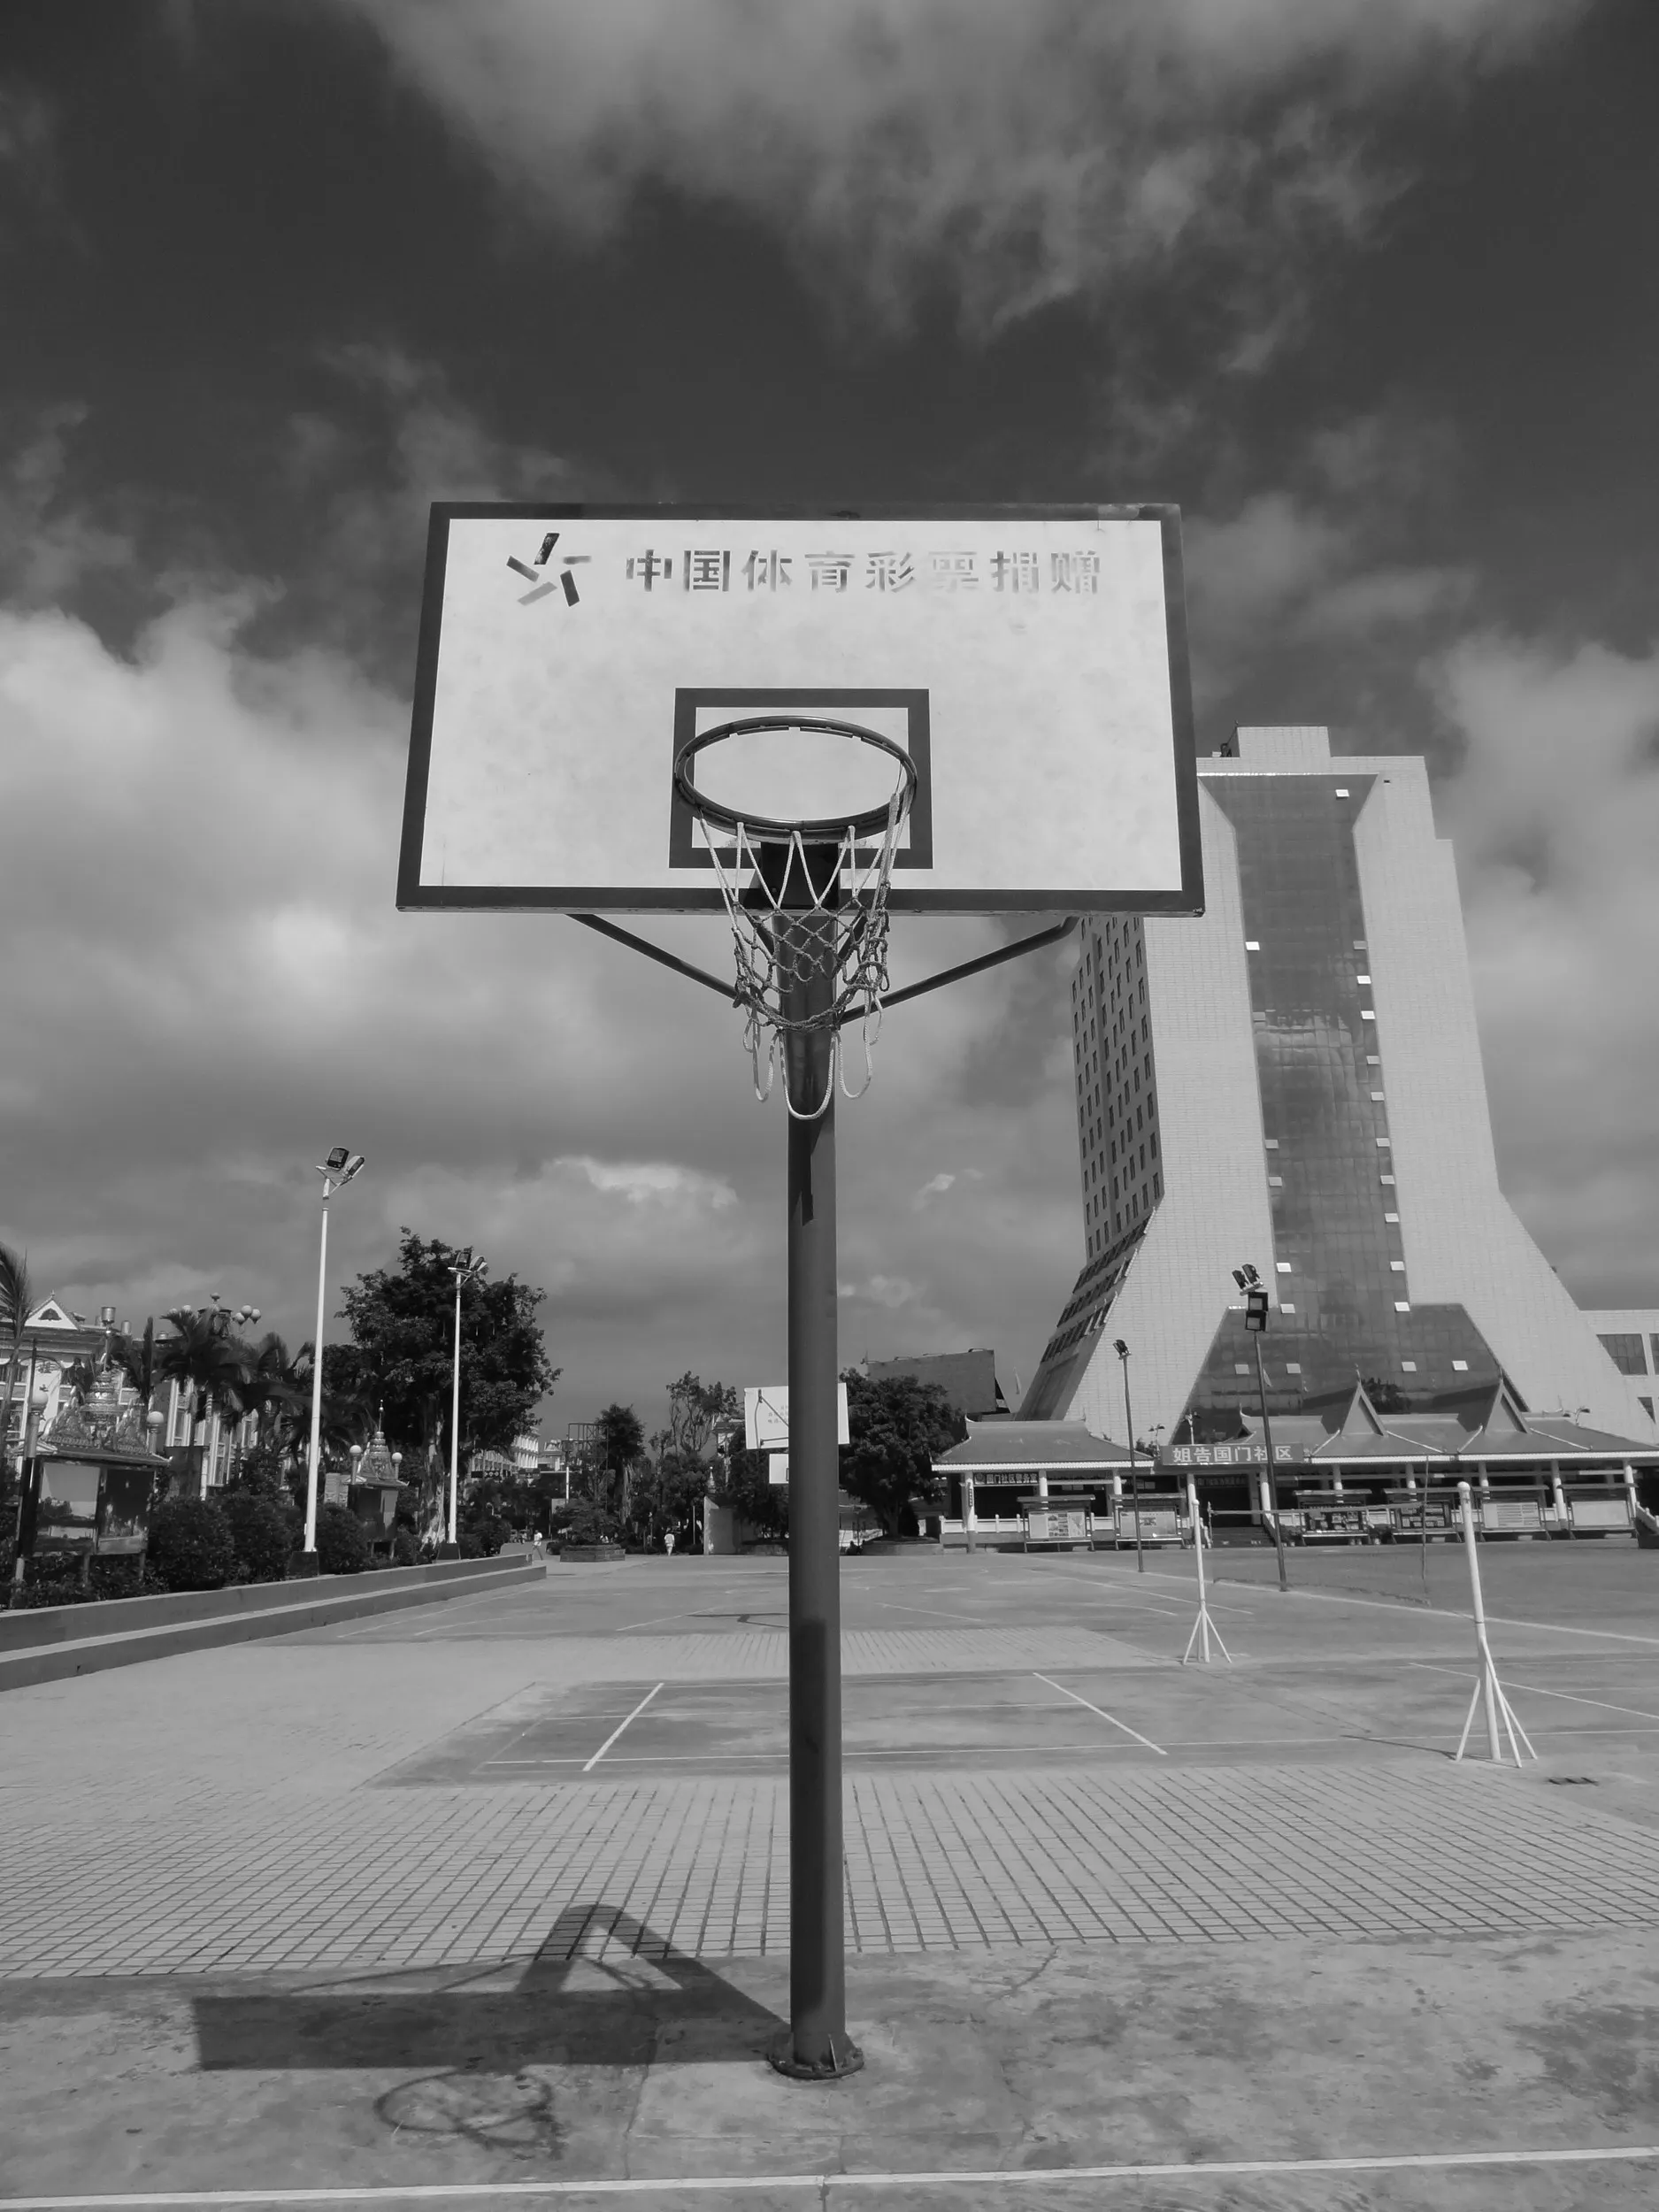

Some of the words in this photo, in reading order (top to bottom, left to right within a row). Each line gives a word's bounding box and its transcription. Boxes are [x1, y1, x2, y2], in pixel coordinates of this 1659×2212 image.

[625, 549, 1102, 594] 中国体育彩票捐赠
[1172, 1446, 1294, 1463] 姐告国门社区
